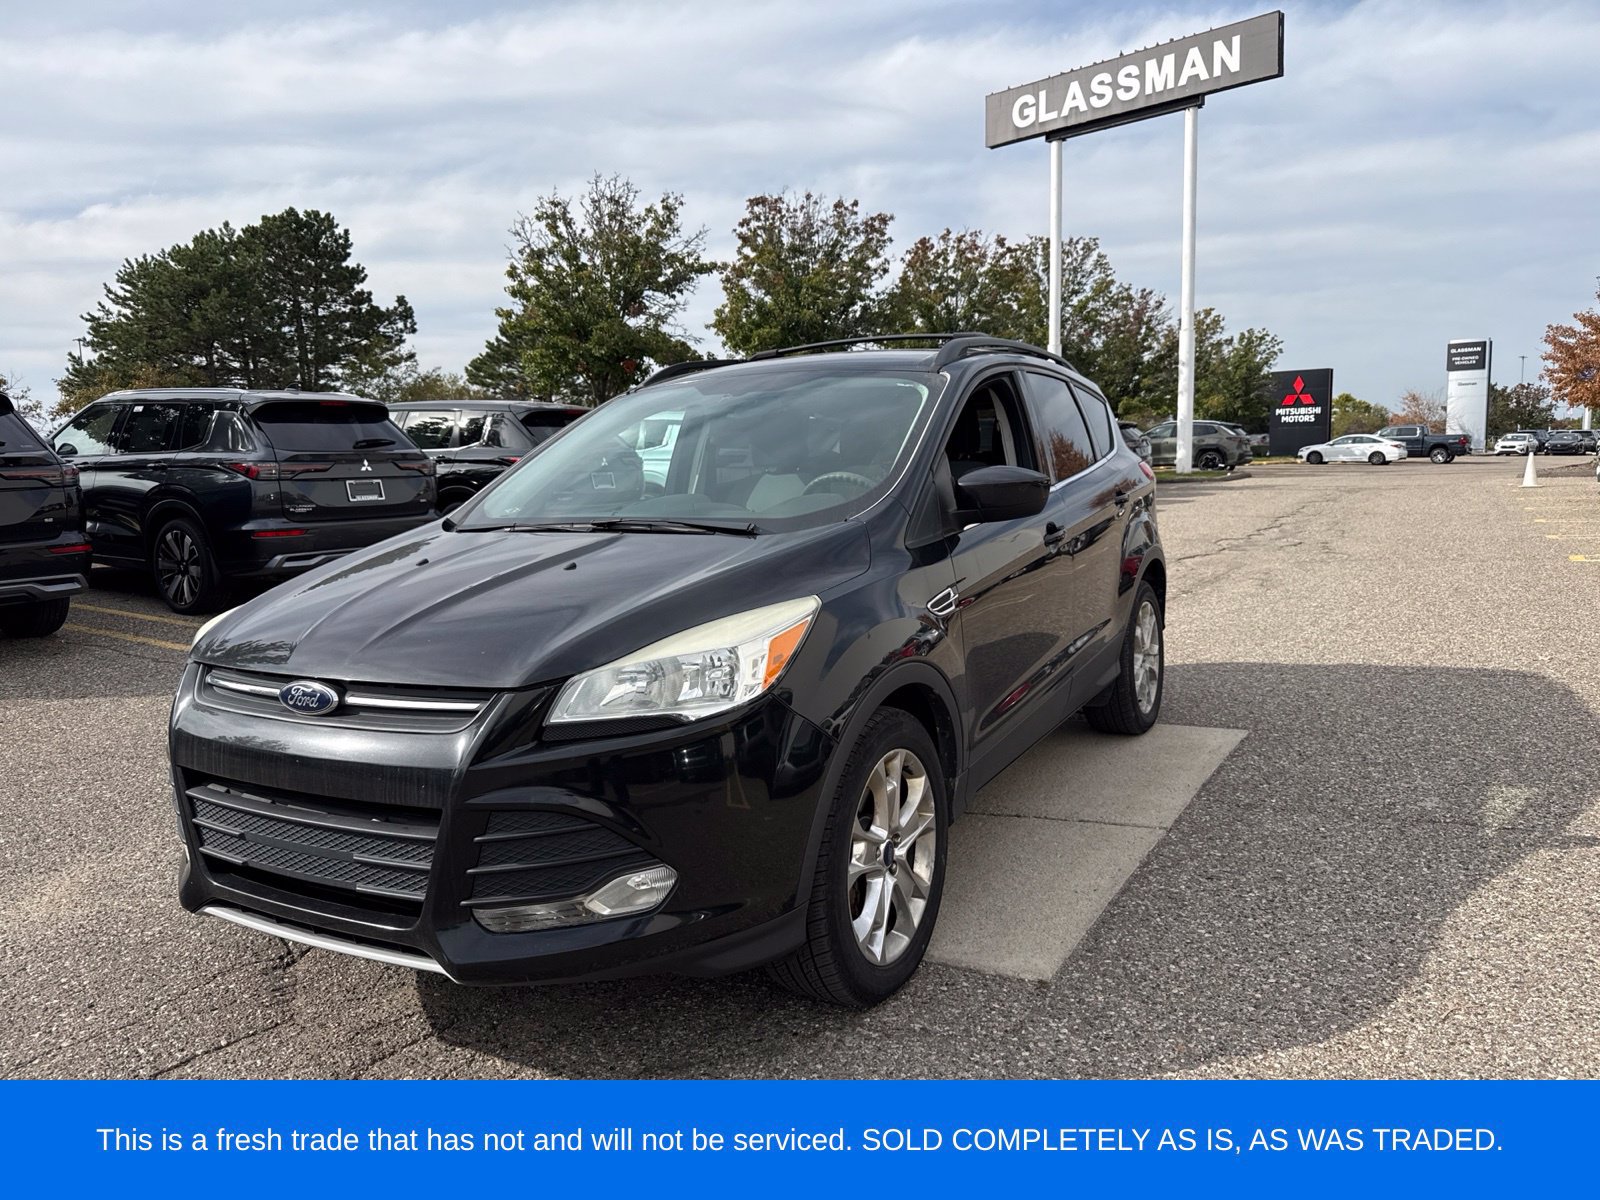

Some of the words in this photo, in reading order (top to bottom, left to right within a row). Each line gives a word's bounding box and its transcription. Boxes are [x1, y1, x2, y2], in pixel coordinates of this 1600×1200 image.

[1012, 35, 1241, 128] GLASSMAN
[1276, 407, 1321, 416] MITSUBISHI
[1281, 415, 1315, 423] MOTORS
[287, 685, 321, 708] Ford
